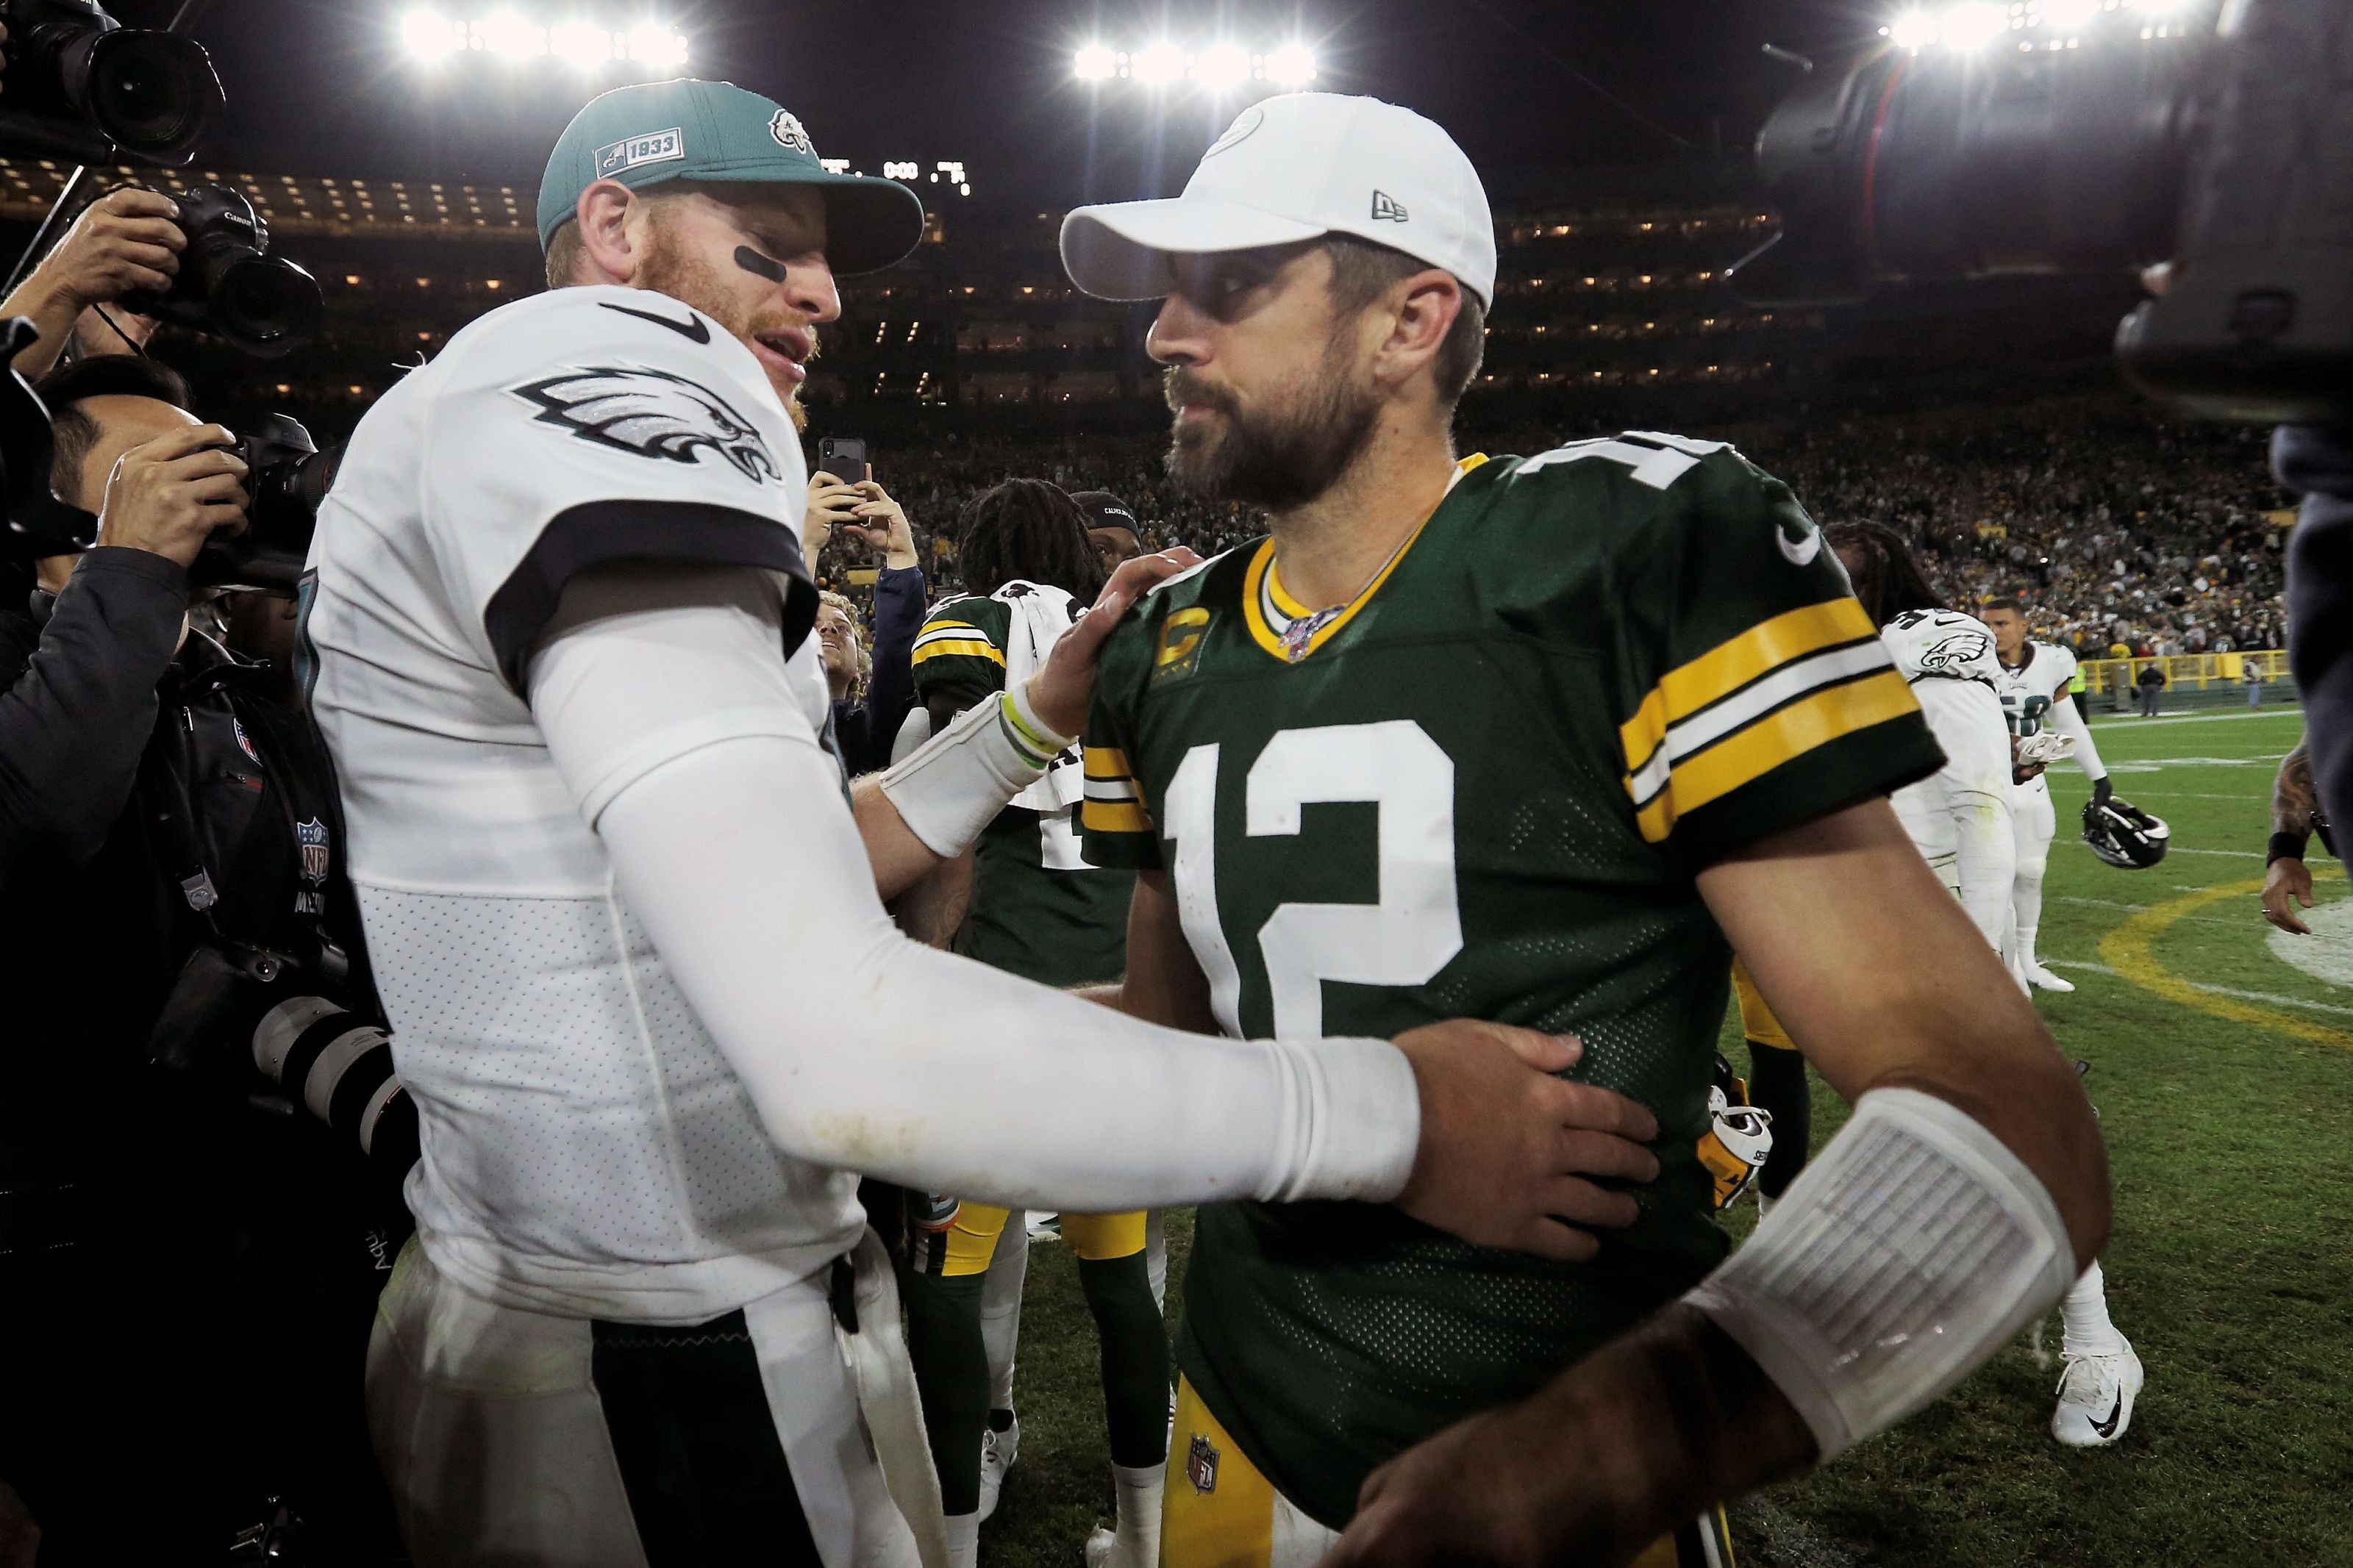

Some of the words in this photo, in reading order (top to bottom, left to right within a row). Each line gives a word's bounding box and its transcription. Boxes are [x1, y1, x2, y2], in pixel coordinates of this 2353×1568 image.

[630, 136, 674, 159] 1933
[224, 211, 251, 227] Canon
[1157, 606, 1210, 667] C
[1163, 718, 1465, 1042] 12
